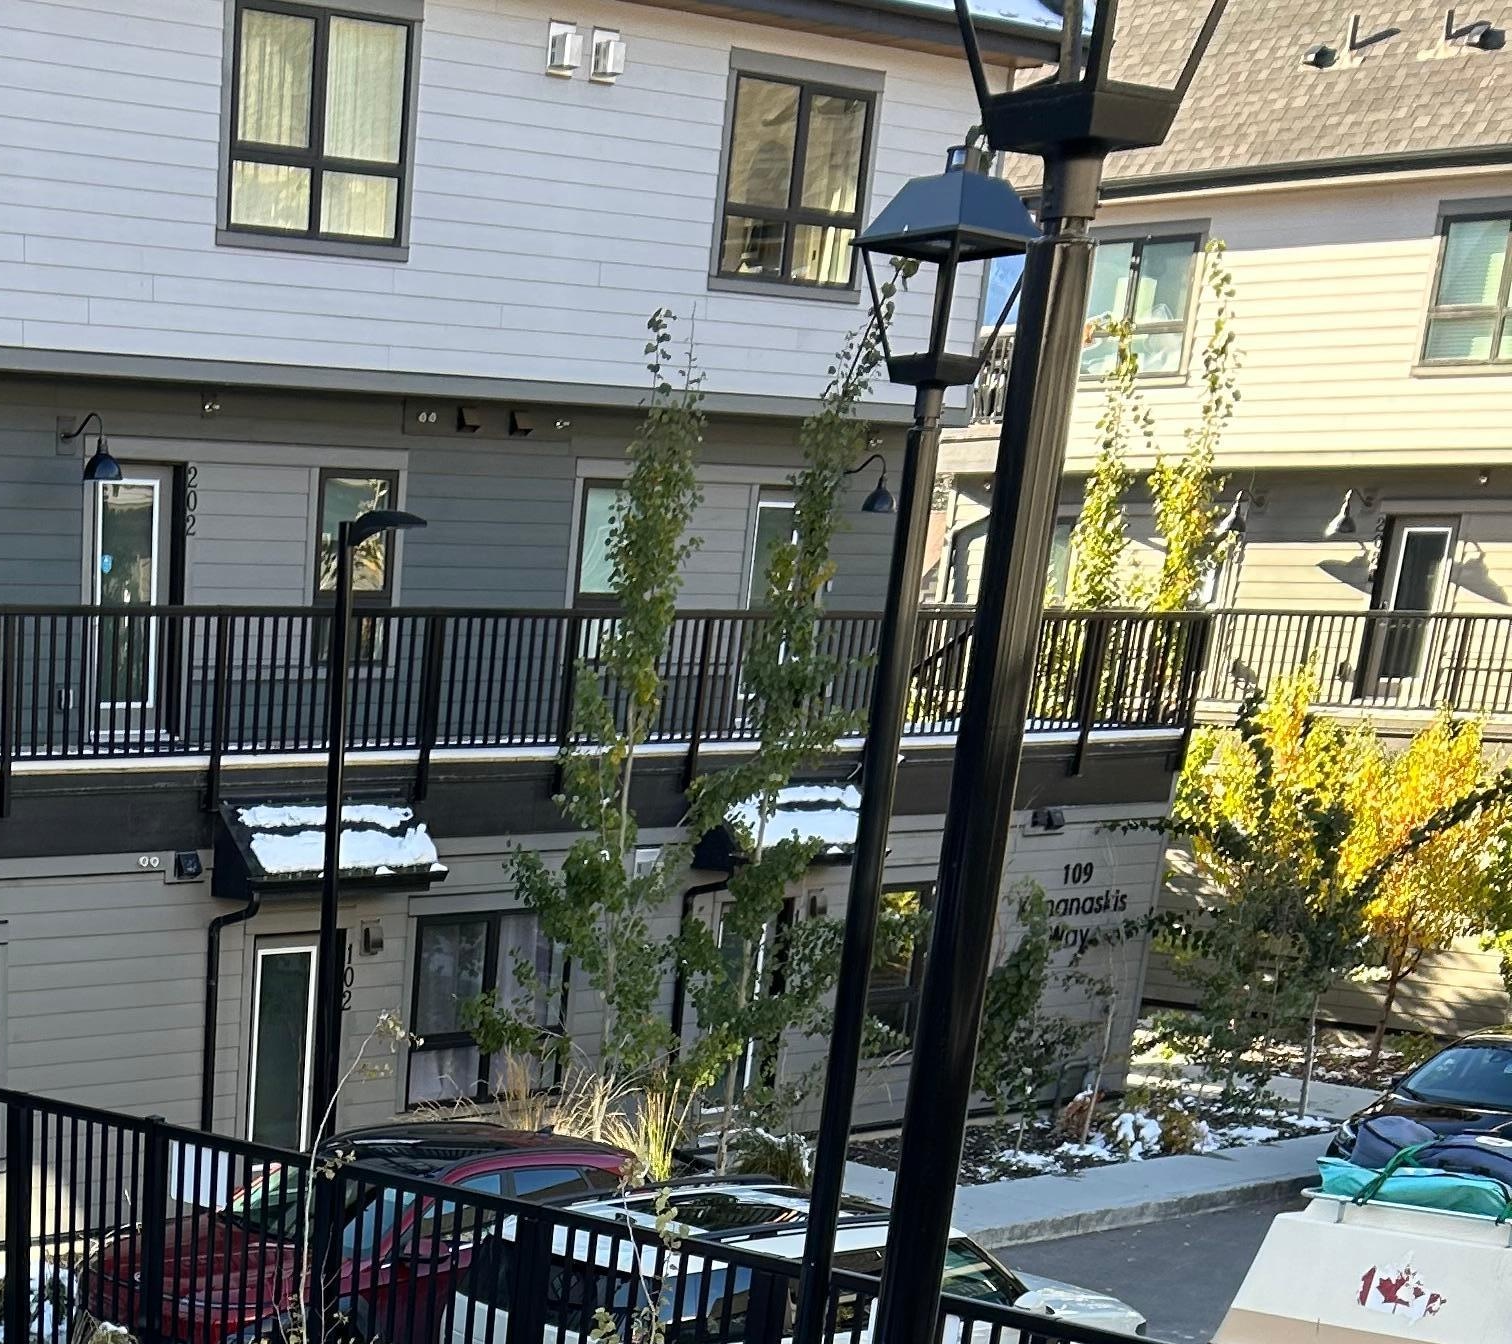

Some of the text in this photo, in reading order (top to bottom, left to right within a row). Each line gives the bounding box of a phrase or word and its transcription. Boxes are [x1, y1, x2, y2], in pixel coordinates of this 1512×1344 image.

[185, 466, 198, 537] 202
[1062, 862, 1095, 886] 109
[341, 943, 355, 1011] 102
